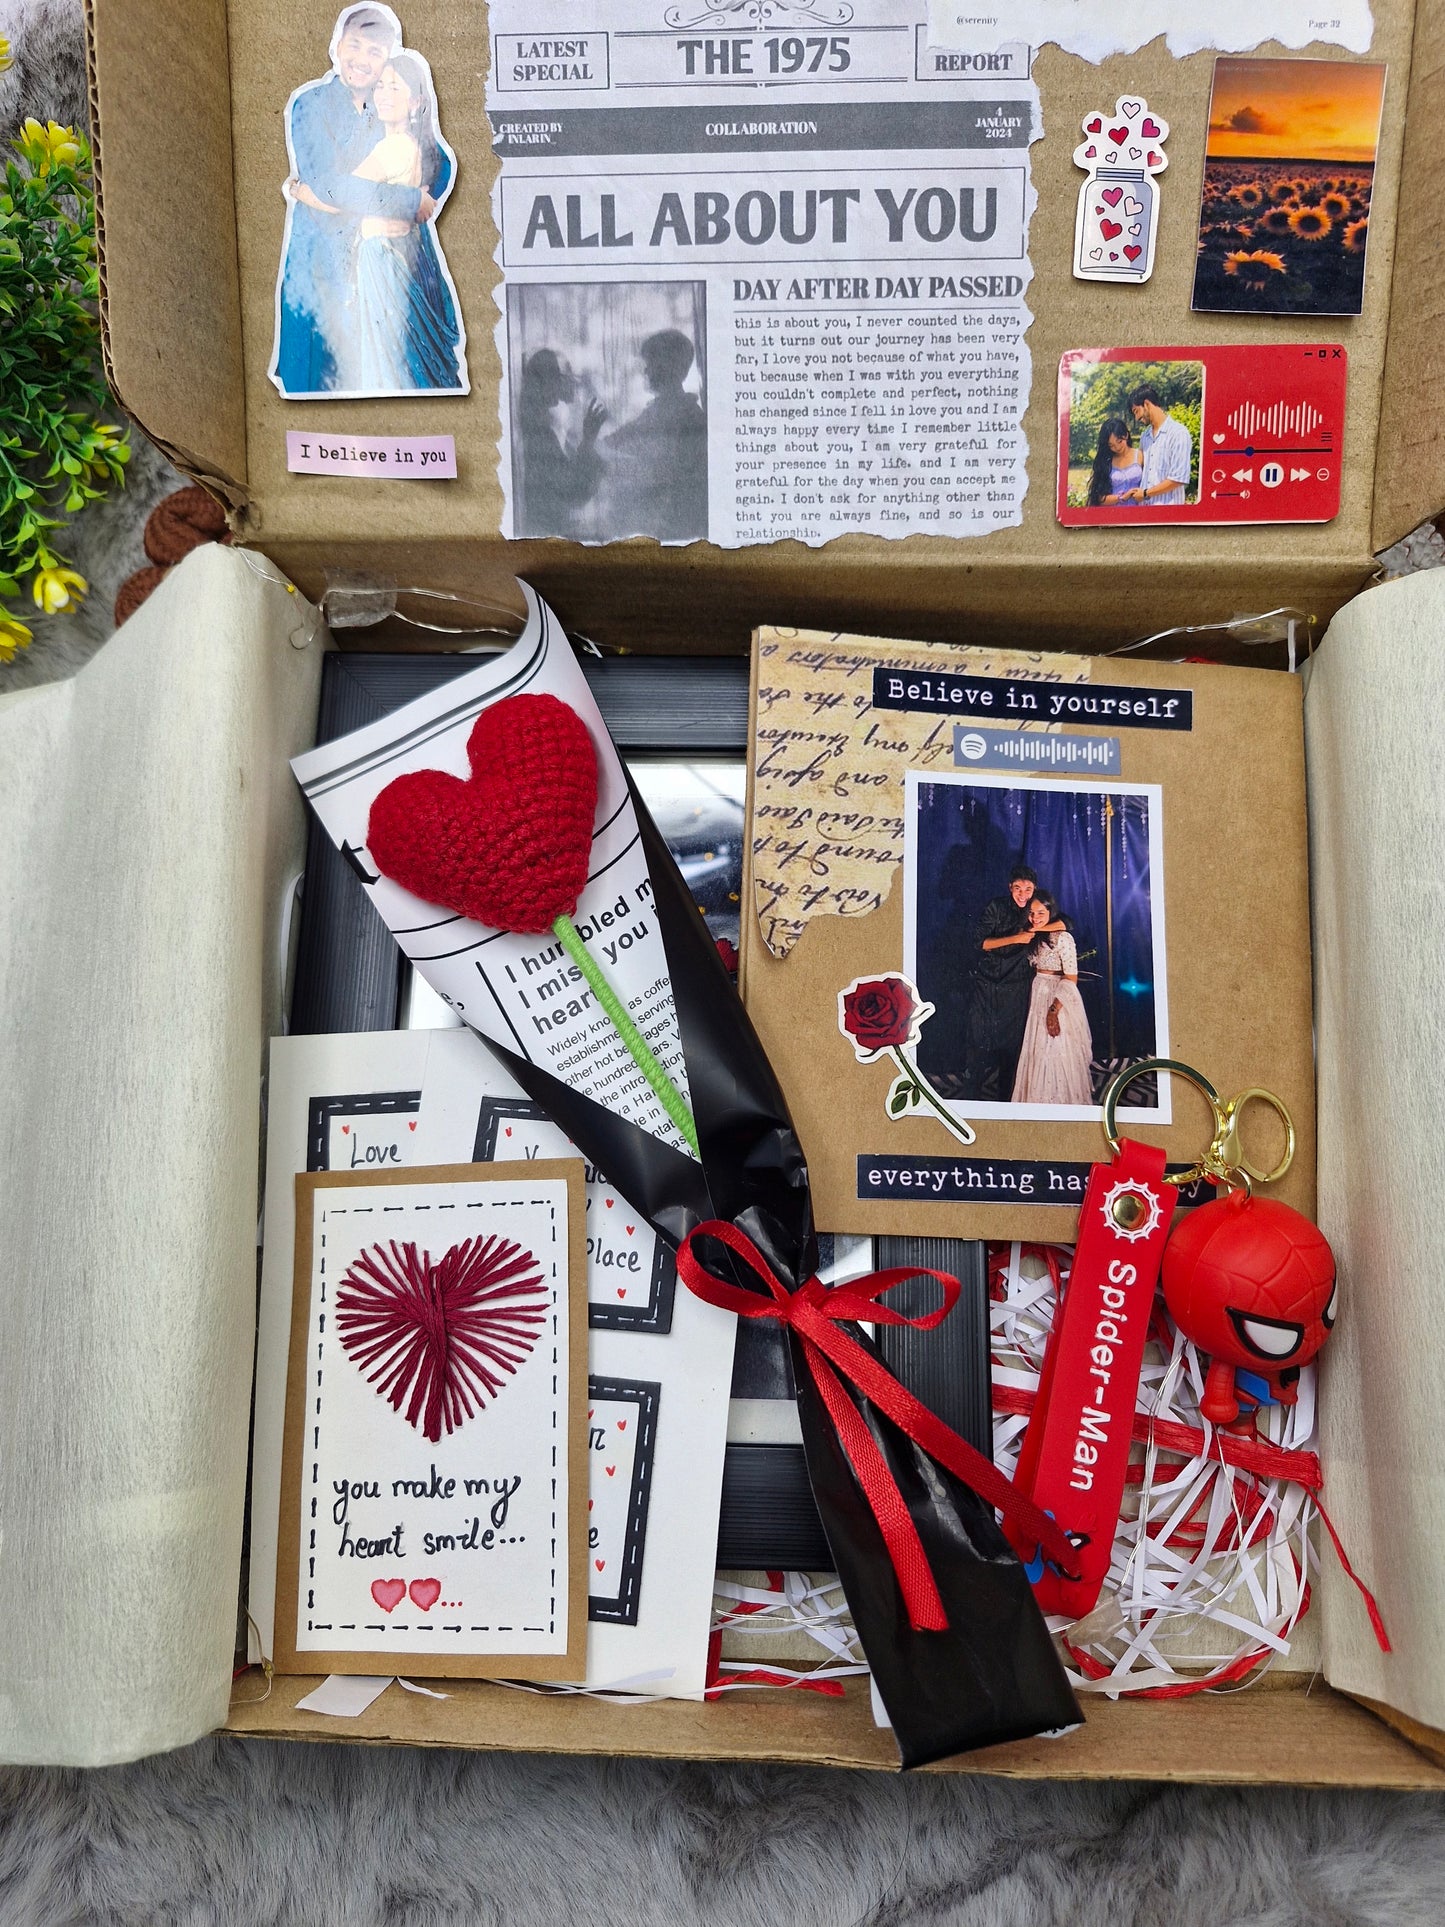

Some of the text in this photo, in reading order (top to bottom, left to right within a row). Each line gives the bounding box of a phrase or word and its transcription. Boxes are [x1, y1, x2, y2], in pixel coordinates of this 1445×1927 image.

[1308, 19, 1328, 29] Page
[516, 40, 589, 58] LATEST
[676, 37, 851, 75] THE 1975
[513, 63, 593, 81] SPECIAL
[935, 54, 1013, 71] REPORT
[499, 122, 563, 134] CREATED BY
[705, 121, 818, 136] COLLABORATION
[975, 117, 1023, 128] JANUARY
[985, 128, 1012, 138] 2024
[521, 186, 998, 249] ALL ABOUT YOU
[733, 275, 1023, 301] DAY AFTER DAY PASSED
[734, 313, 1020, 331] this is about you, I never counted the days,
[734, 332, 1020, 348] but it turns out our journey has been very
[735, 349, 1019, 367] far, I love you not because of what you have,
[734, 367, 1019, 384] but because when I was with you everything
[735, 385, 1018, 404] you couldn't complete and perfect, nothing
[735, 402, 1017, 421] has changed since I fell in love you and I am
[735, 420, 1017, 439] always happy every time I remember little
[300, 444, 447, 466] I believe in you
[736, 437, 1017, 456] things about you, I am very grateful for
[735, 456, 1016, 474] your presence in my life. and I am very
[736, 473, 1016, 491] grateful for the day when you can accept me
[736, 489, 1014, 508] again. I don't ask for anything other than
[736, 508, 1015, 525] that you are always fine, and so is our
[888, 678, 1179, 719] Believe in yourself
[504, 964, 517, 984] I
[518, 920, 649, 1009] I you
[638, 994, 675, 1024] serving
[547, 996, 642, 1056] Widely as
[594, 1053, 615, 1071] hot
[600, 1090, 619, 1107] the
[351, 1133, 402, 1168] Love
[868, 1166, 1034, 1194] everything
[1069, 1259, 1137, 1492] Spider-Man
[333, 1464, 521, 1529] you make my
[338, 1522, 406, 1558] heart
